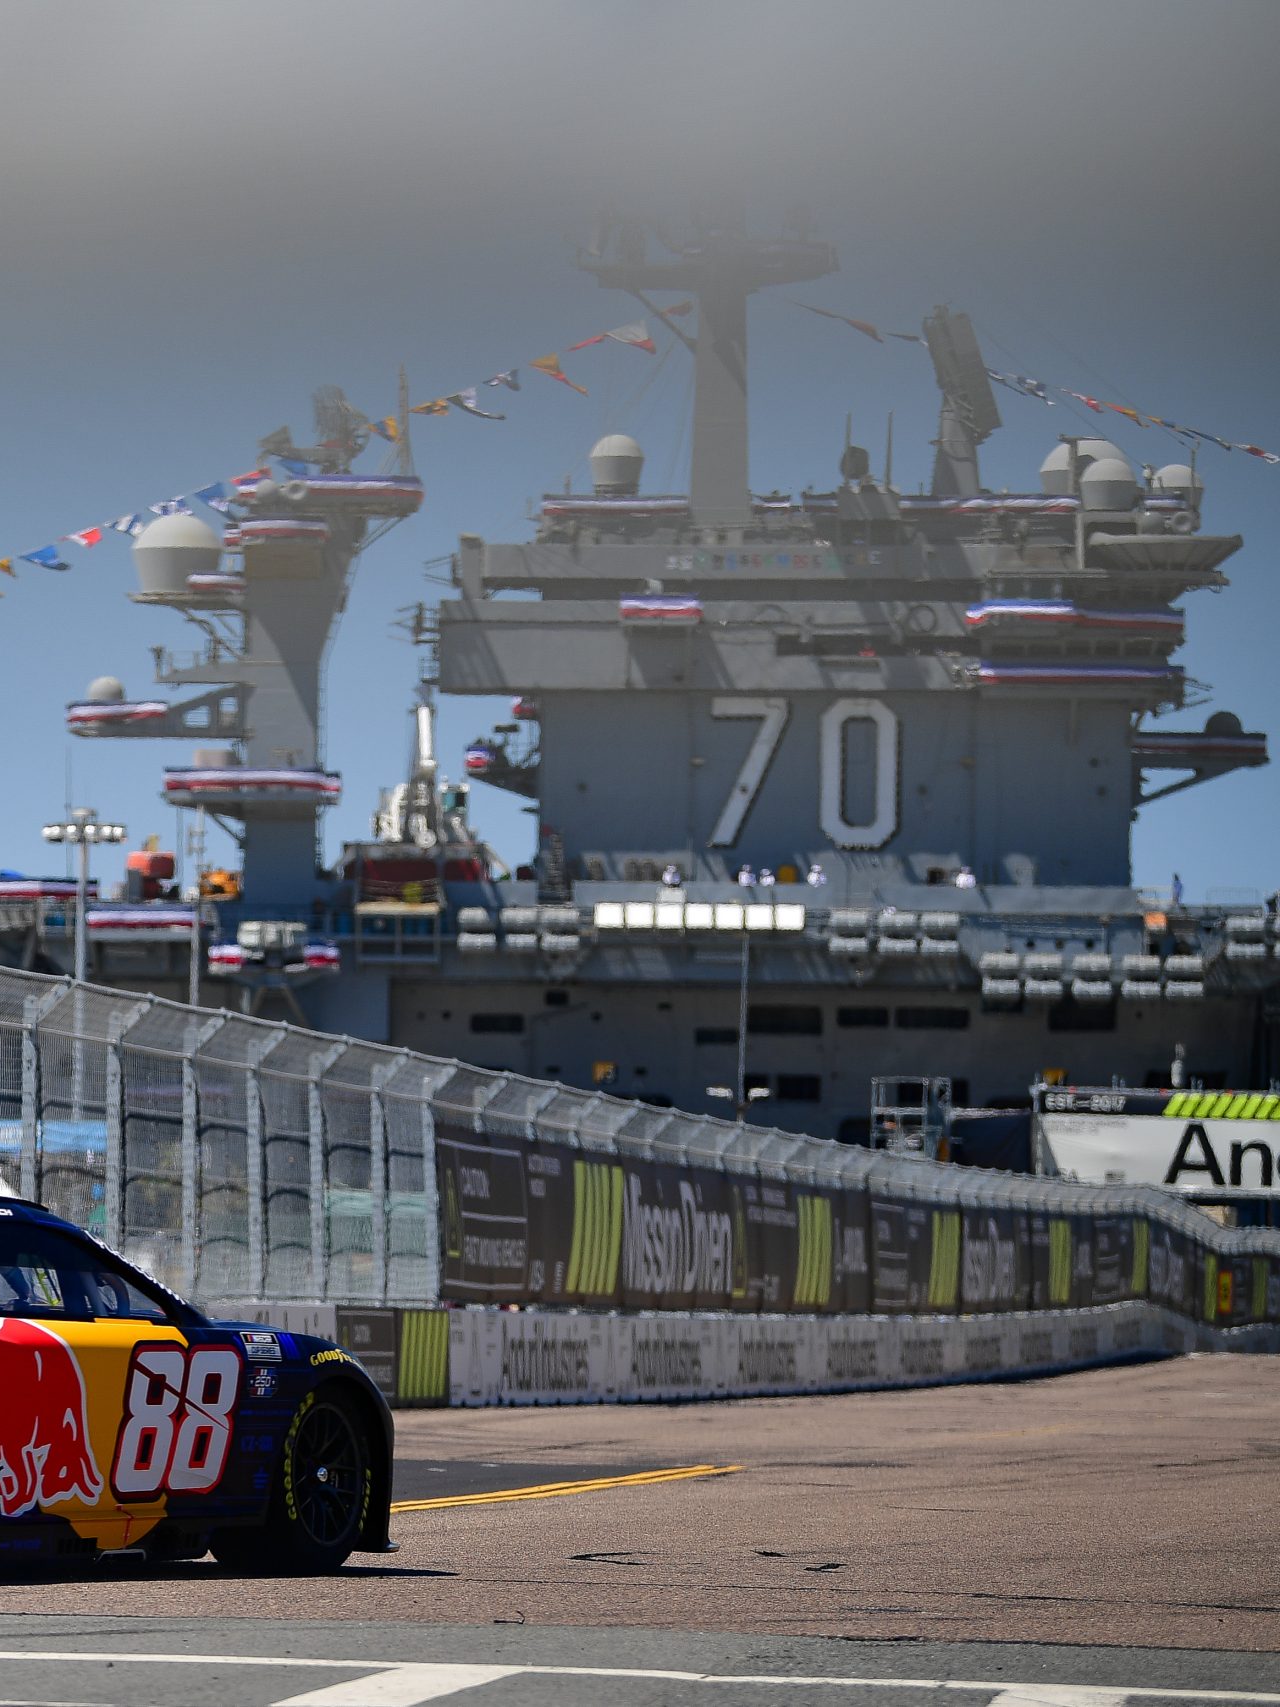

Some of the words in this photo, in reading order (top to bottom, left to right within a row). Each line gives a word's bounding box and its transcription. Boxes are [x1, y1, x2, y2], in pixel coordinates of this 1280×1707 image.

[707, 698, 901, 851] 70
[1163, 1120, 1280, 1187] An
[113, 1349, 241, 1493] 88
[253, 1376, 272, 1388] 250
